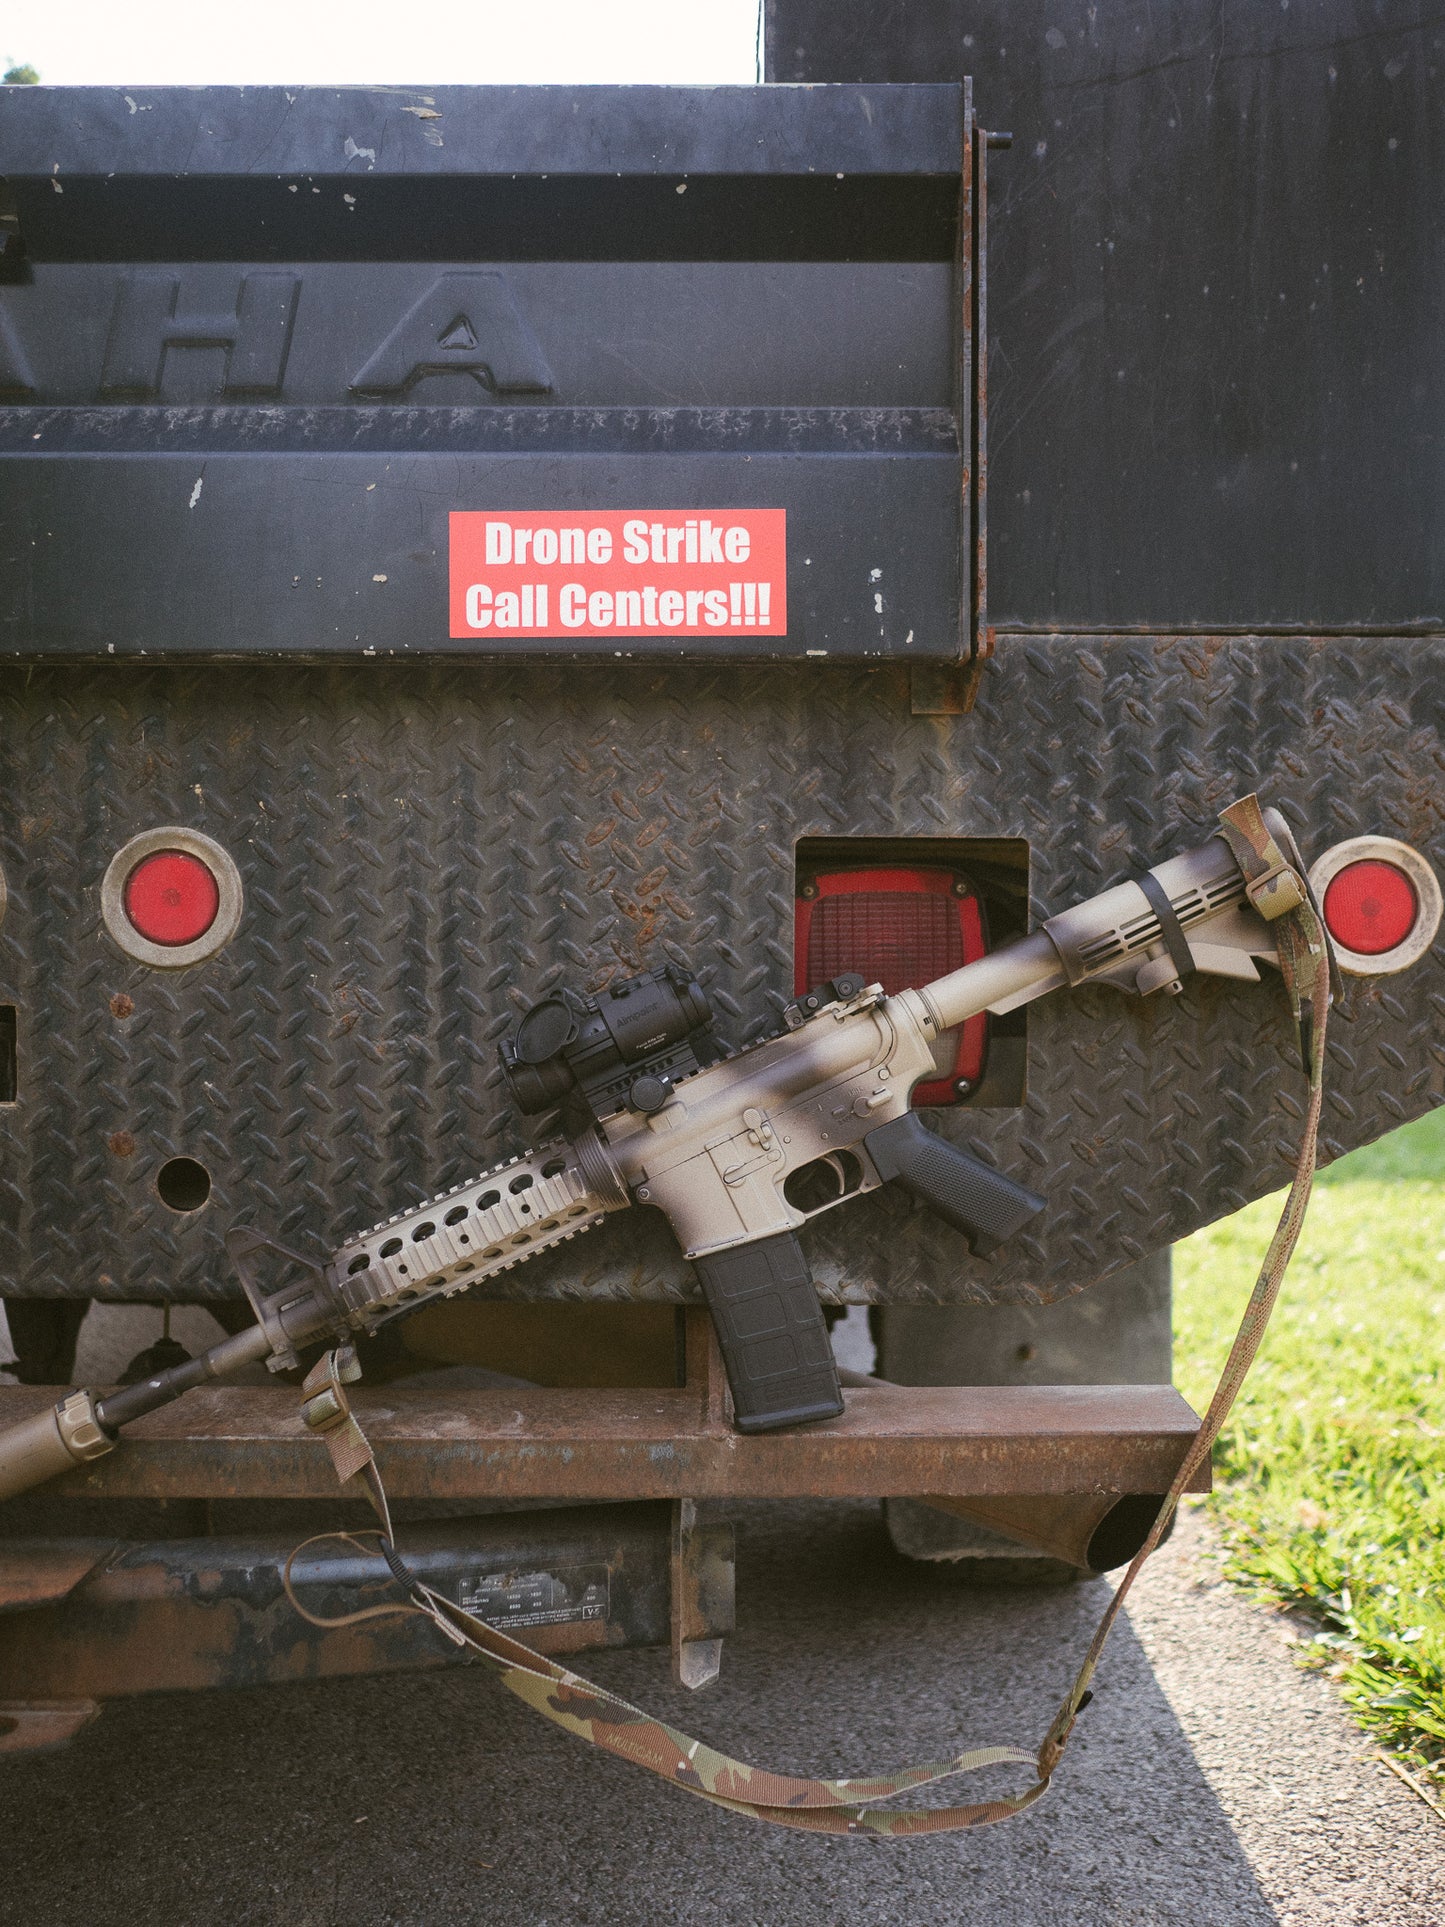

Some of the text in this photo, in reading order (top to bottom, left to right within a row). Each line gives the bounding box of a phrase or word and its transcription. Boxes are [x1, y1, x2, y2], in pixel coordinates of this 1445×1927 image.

[0, 270, 556, 396] HA
[485, 519, 750, 565] Drone Strike
[465, 582, 771, 628] Call Centers!!!
